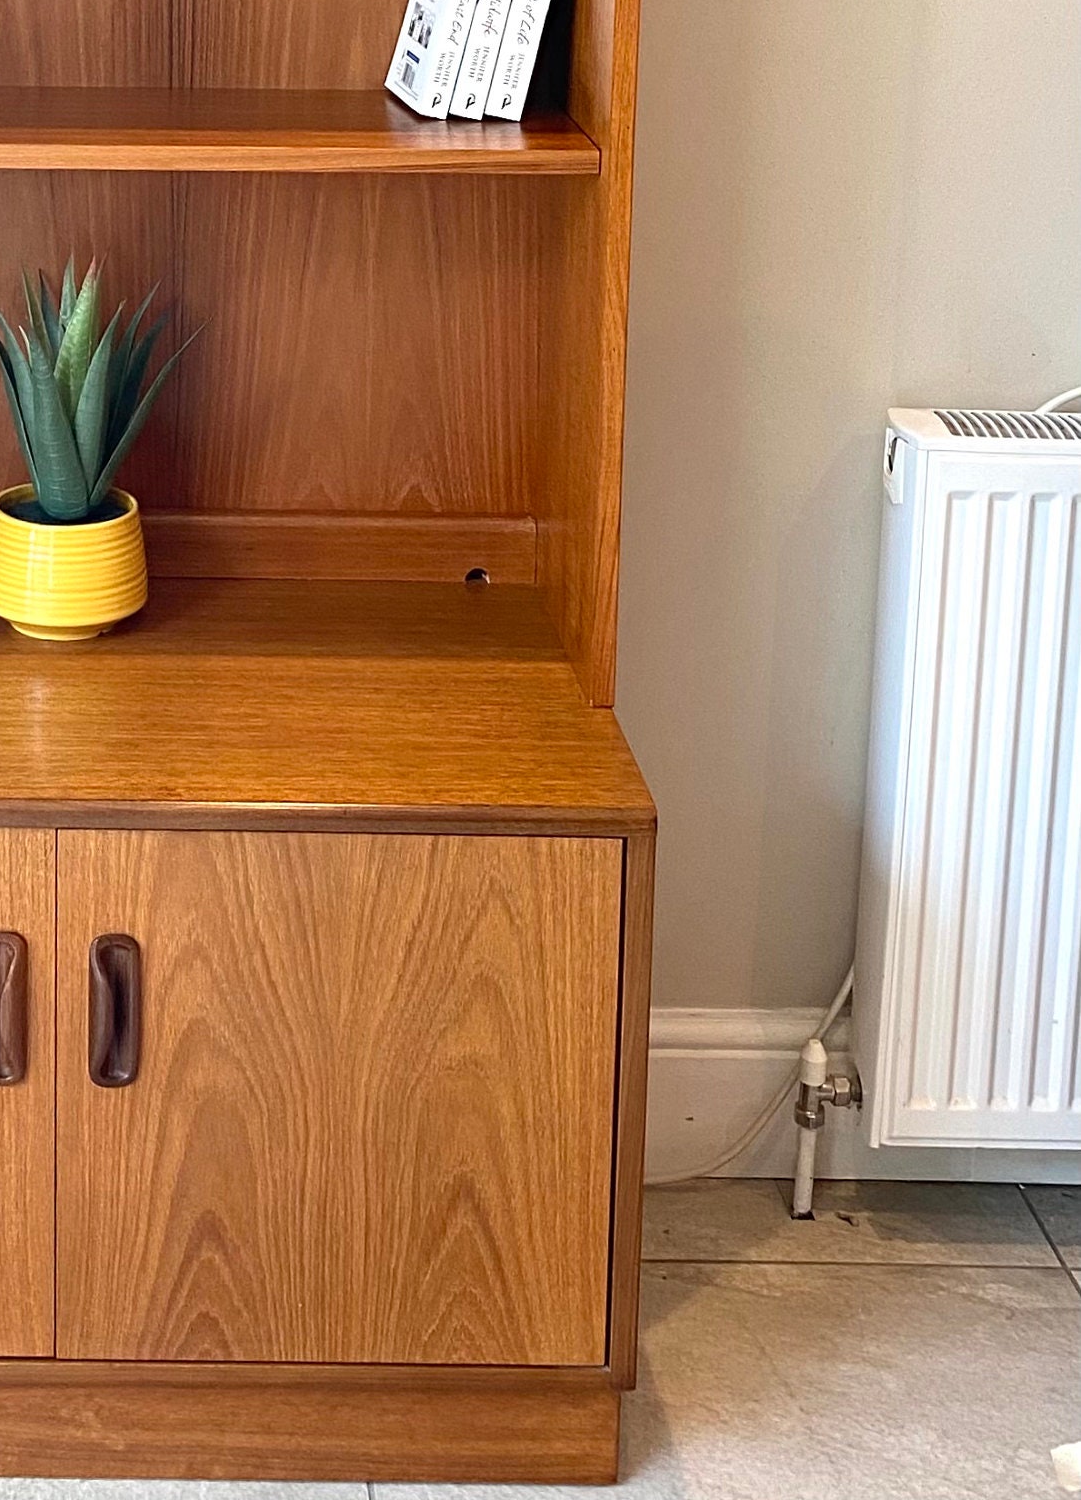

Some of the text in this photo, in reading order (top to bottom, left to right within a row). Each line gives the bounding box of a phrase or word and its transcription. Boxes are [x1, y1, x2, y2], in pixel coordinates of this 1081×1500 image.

[522, 4, 536, 24] of
[447, 20, 463, 46] End
[516, 19, 531, 45] Life
